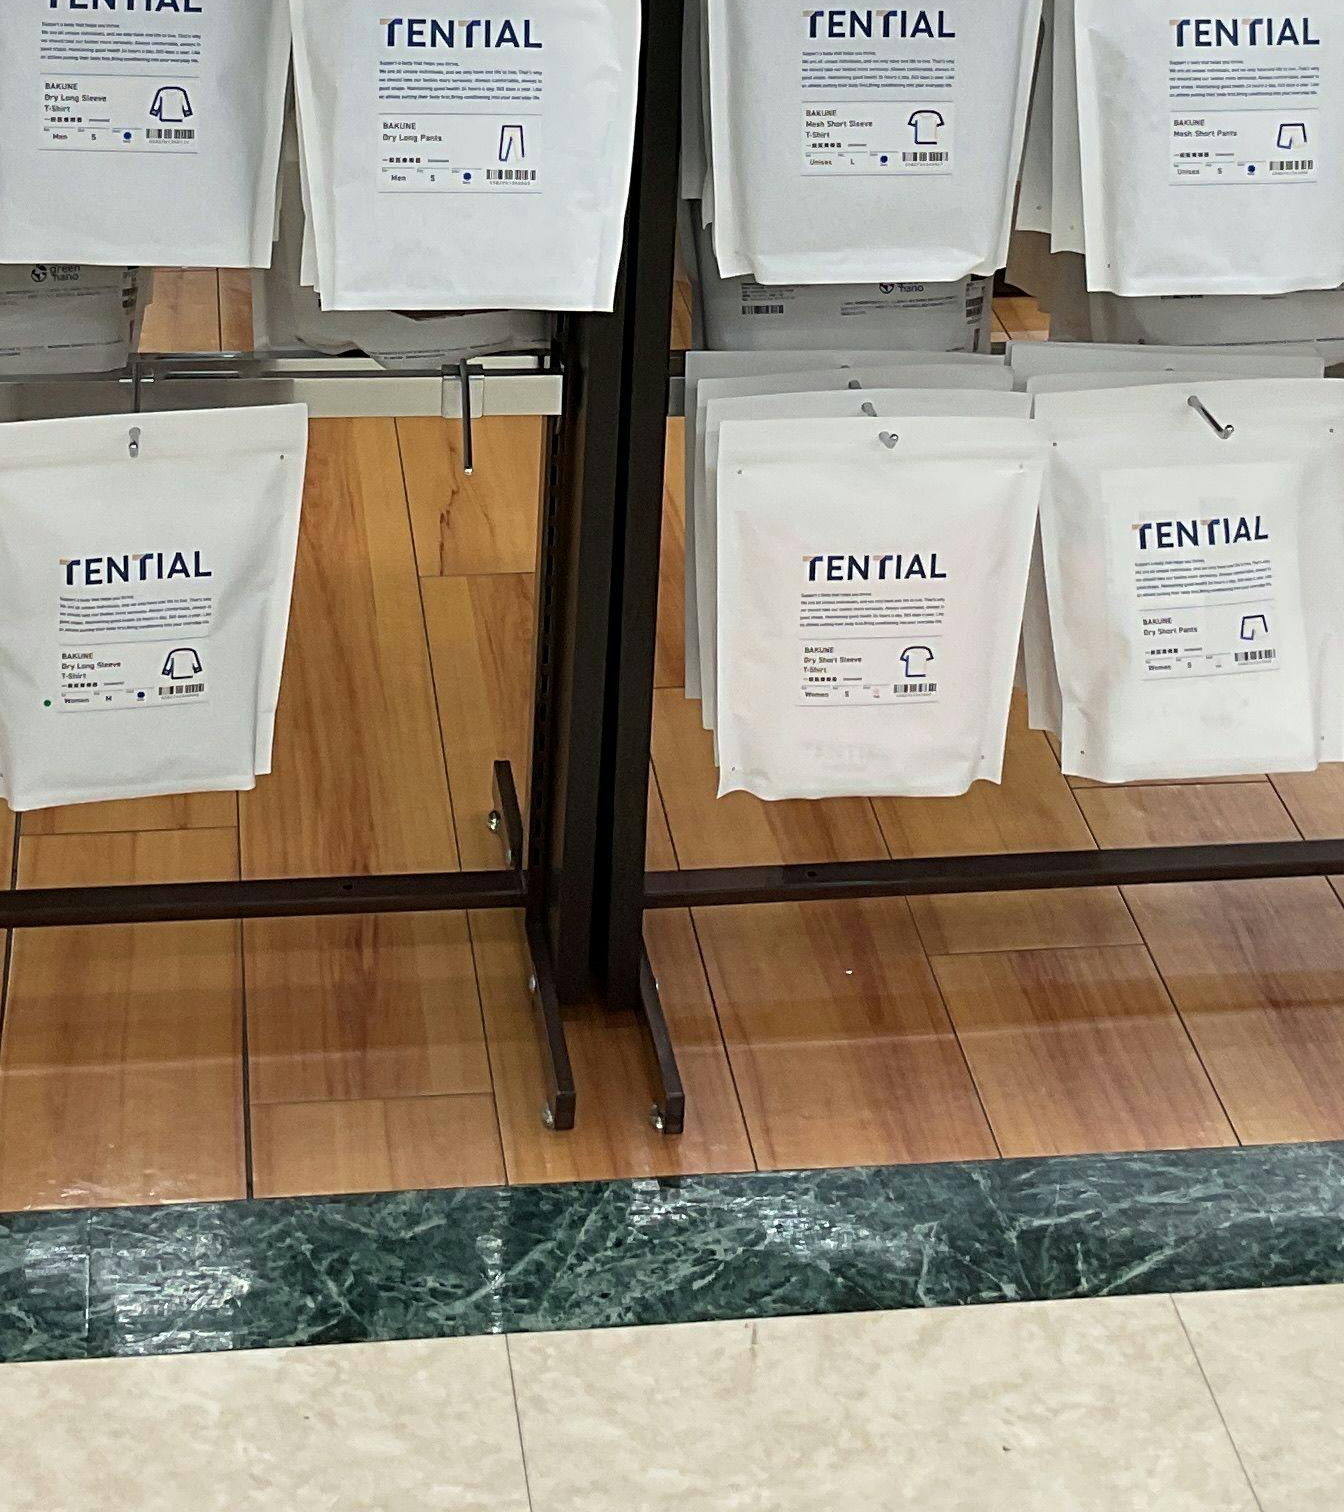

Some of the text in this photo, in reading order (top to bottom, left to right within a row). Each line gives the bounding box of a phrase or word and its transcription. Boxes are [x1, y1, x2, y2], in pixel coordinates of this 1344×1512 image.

[380, 18, 542, 48] TENTIAL
[800, 10, 955, 38] TENTIAL
[1169, 18, 1320, 47] TENTIAL
[45, 94, 58, 103] Dry
[61, 95, 79, 103] Long
[383, 134, 442, 142] Dry Long Pants
[1132, 516, 1268, 549] TENTIAL
[60, 551, 211, 585] TENTIAL
[803, 554, 946, 581] TENTIAL
[62, 652, 93, 660] BAKUNE
[77, 662, 95, 670] Long
[97, 661, 121, 669] Sleeve
